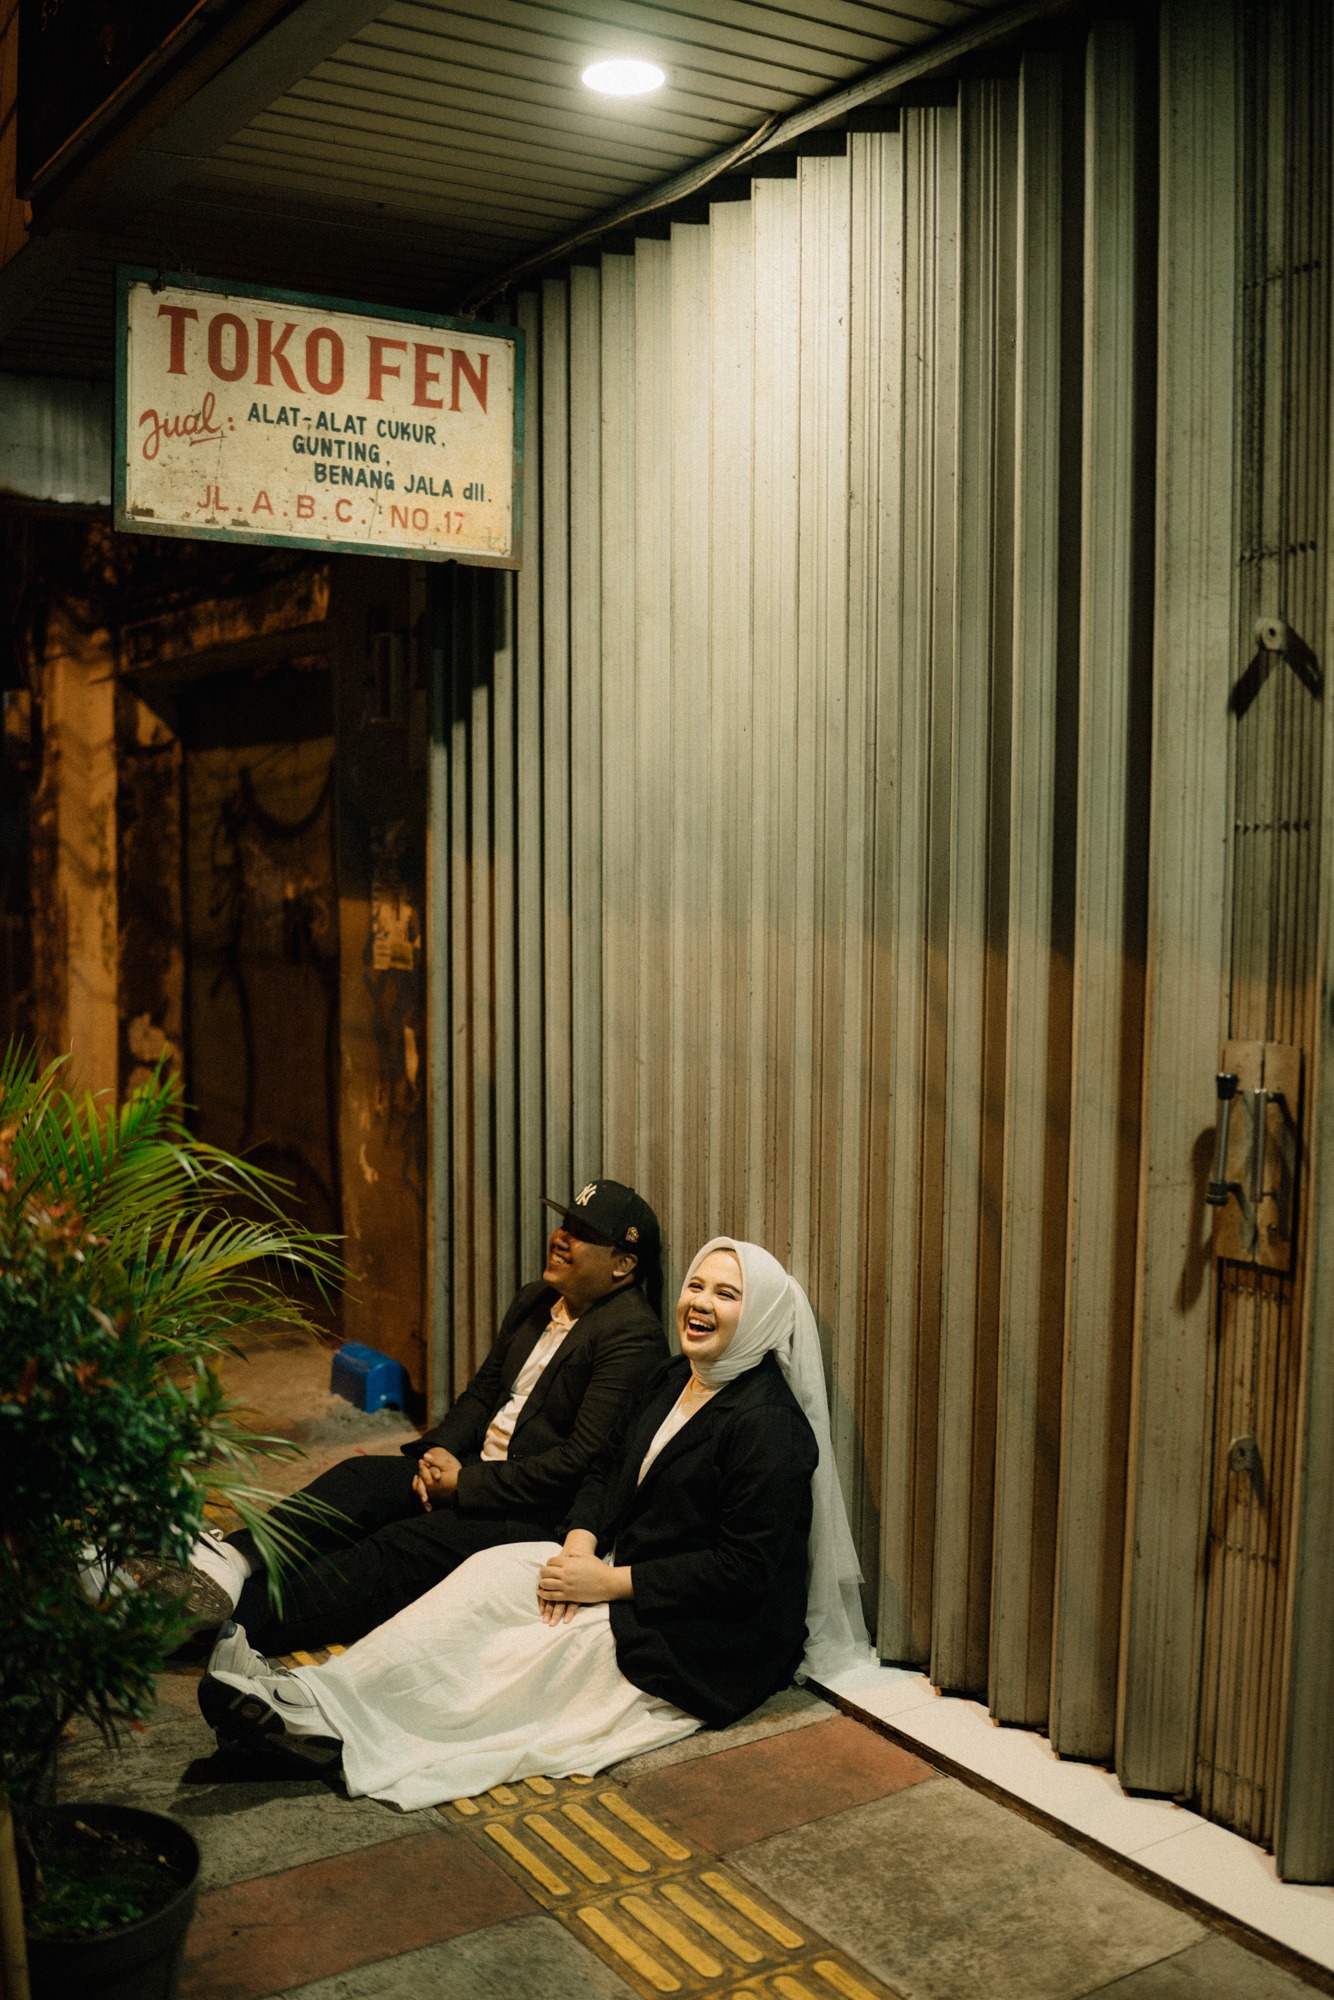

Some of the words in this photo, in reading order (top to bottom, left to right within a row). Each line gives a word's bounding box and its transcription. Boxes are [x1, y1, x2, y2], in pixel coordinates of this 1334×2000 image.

[157, 304, 345, 396] TOKO
[366, 335, 491, 415] FEN
[314, 462, 395, 491] BENANG
[403, 474, 454, 498] JALA
